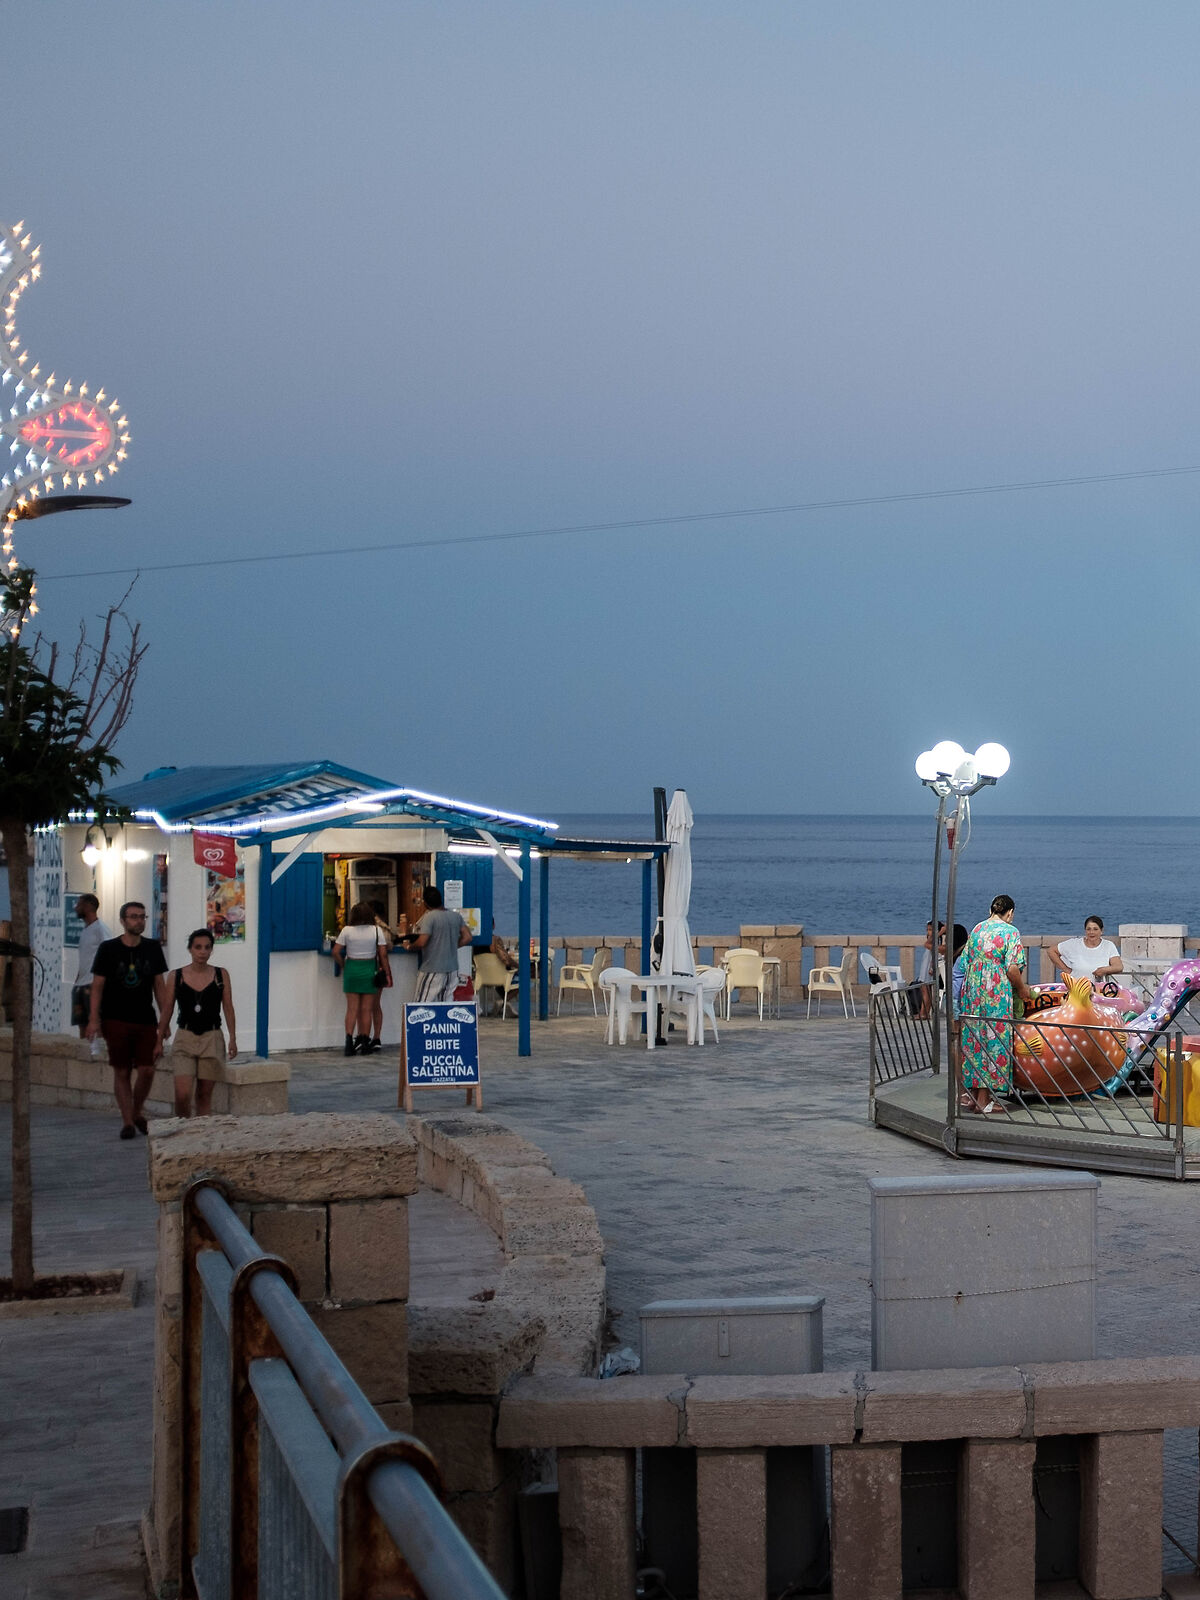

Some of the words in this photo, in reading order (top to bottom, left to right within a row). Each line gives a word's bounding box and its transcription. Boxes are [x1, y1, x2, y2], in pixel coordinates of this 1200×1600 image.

[409, 1011, 430, 1022] GRANITE
[453, 1010, 470, 1021] SPRITZ
[423, 1023, 461, 1034] PANINI
[425, 1039, 460, 1050] BIBITE
[422, 1055, 463, 1066] PUCCIA
[412, 1066, 474, 1077] SALENTINA
